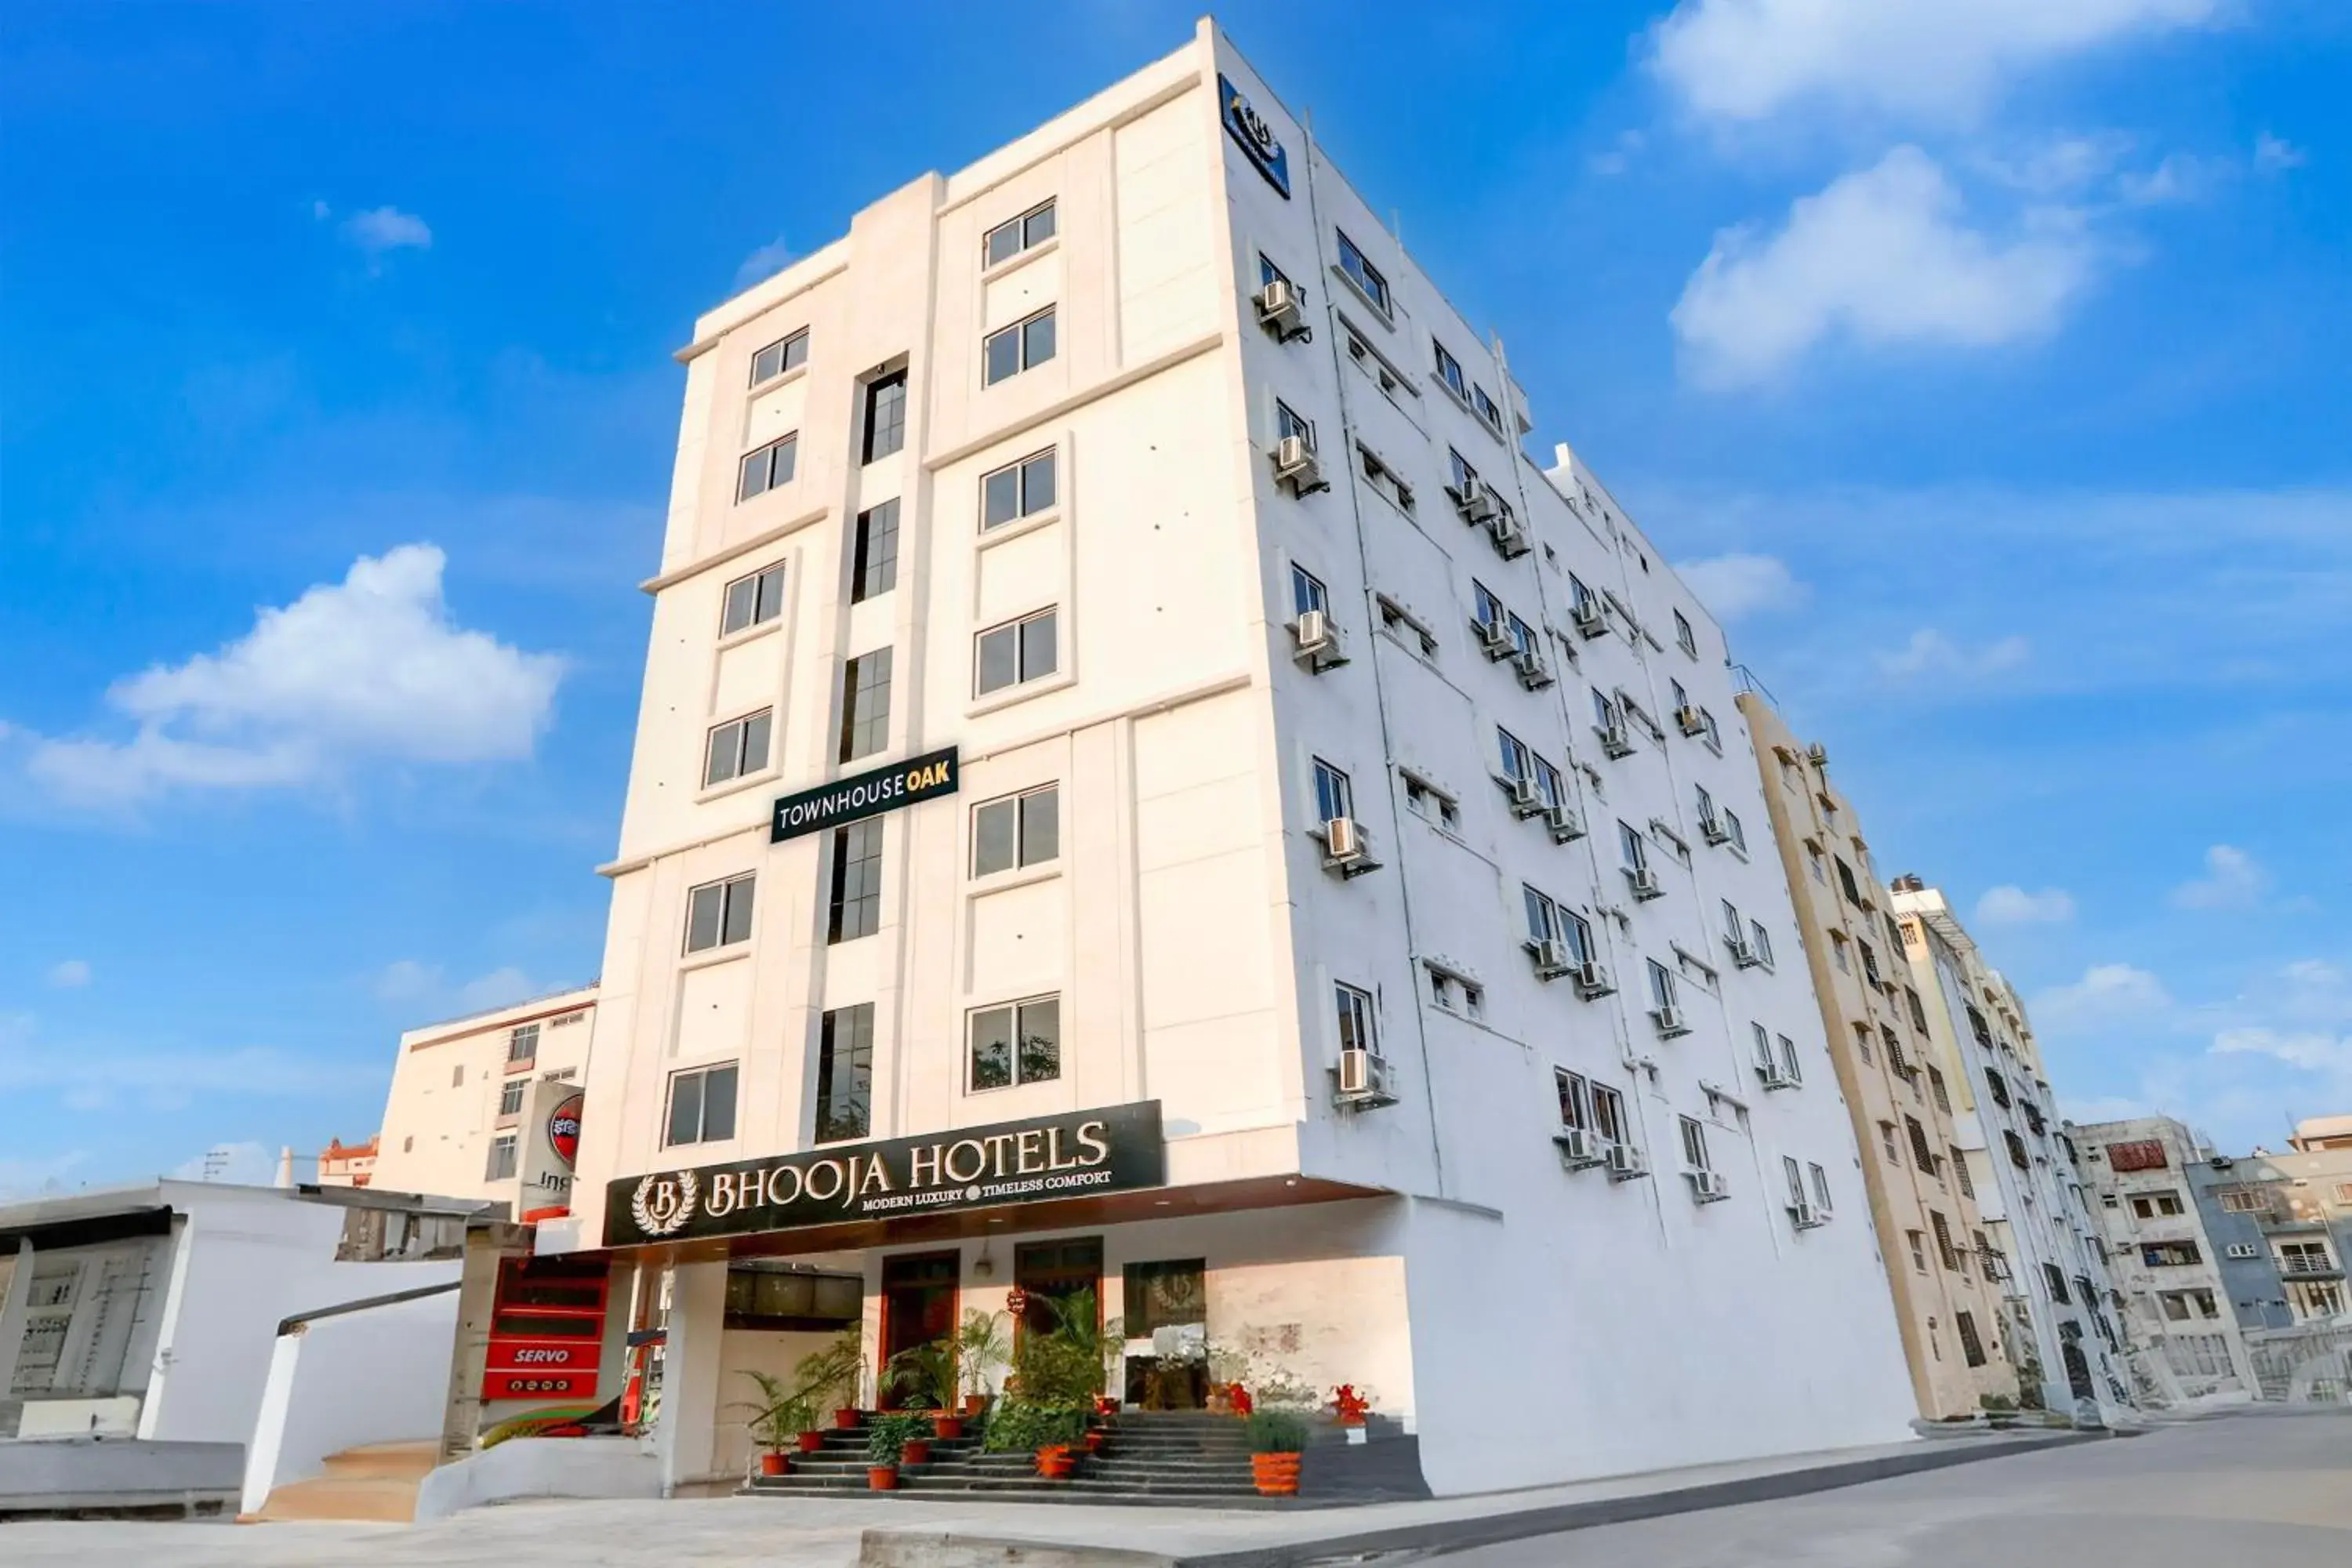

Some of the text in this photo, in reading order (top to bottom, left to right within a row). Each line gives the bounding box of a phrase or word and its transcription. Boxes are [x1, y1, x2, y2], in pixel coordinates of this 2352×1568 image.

[779, 760, 950, 829] TOWNHOUSE OAK
[705, 1120, 1109, 1218] BHOOJA HOTELS
[862, 1171, 1112, 1212] MODERN LUXURY TIMELESS COMFORT
[514, 1348, 570, 1363] SERVO
